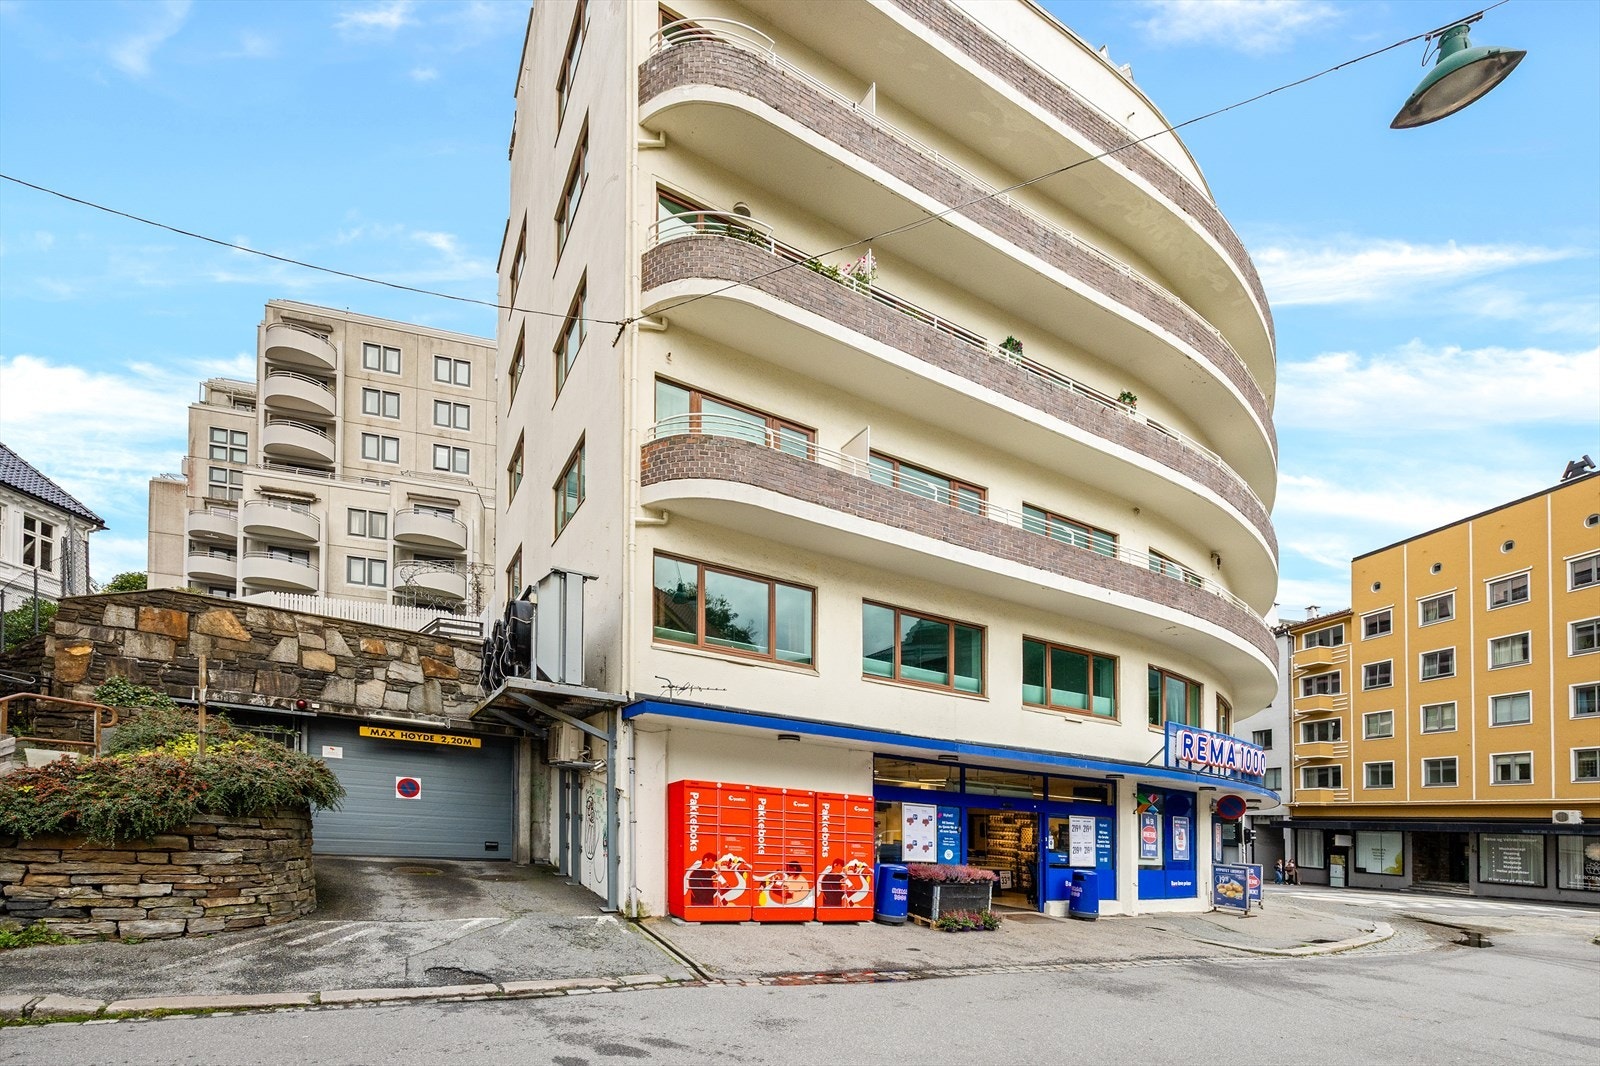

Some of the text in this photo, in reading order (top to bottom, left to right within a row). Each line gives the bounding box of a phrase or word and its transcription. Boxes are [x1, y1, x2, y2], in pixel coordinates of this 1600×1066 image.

[370, 728, 472, 746] MAX HØYDE 2,20M
[1181, 731, 1266, 776] REMA 1000
[689, 791, 700, 852] Pakkeboks
[757, 797, 767, 855] Pakkeboks
[821, 802, 830, 858] Pakkeboks
